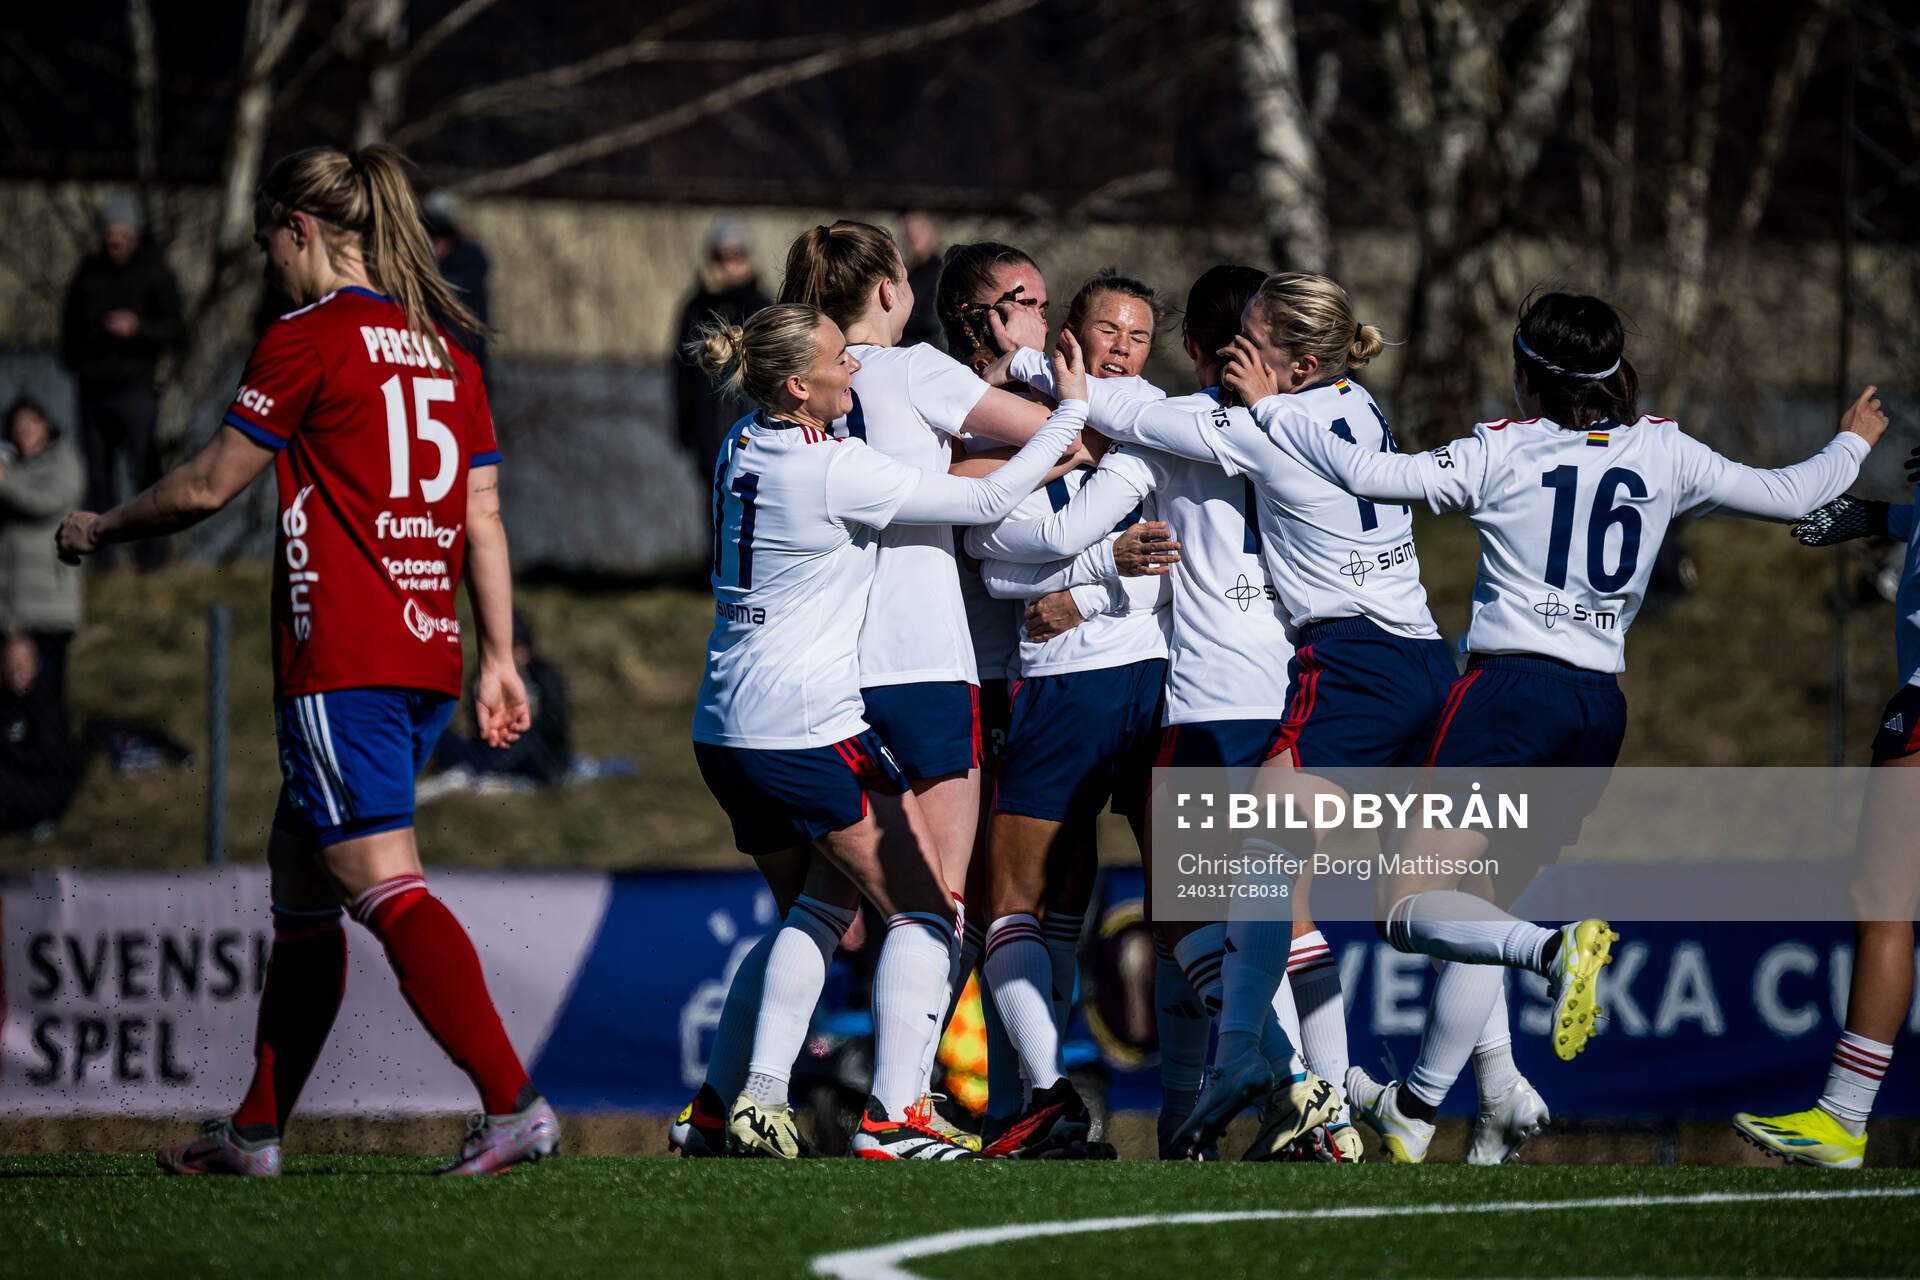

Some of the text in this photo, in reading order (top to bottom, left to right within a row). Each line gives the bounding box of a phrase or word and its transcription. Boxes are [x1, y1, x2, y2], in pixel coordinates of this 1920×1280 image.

[360, 325, 450, 370] PERSSO
[380, 373, 460, 503] 15
[714, 461, 760, 590] 11
[1541, 464, 1648, 593] 16
[25, 1013, 195, 1086] SPEL
